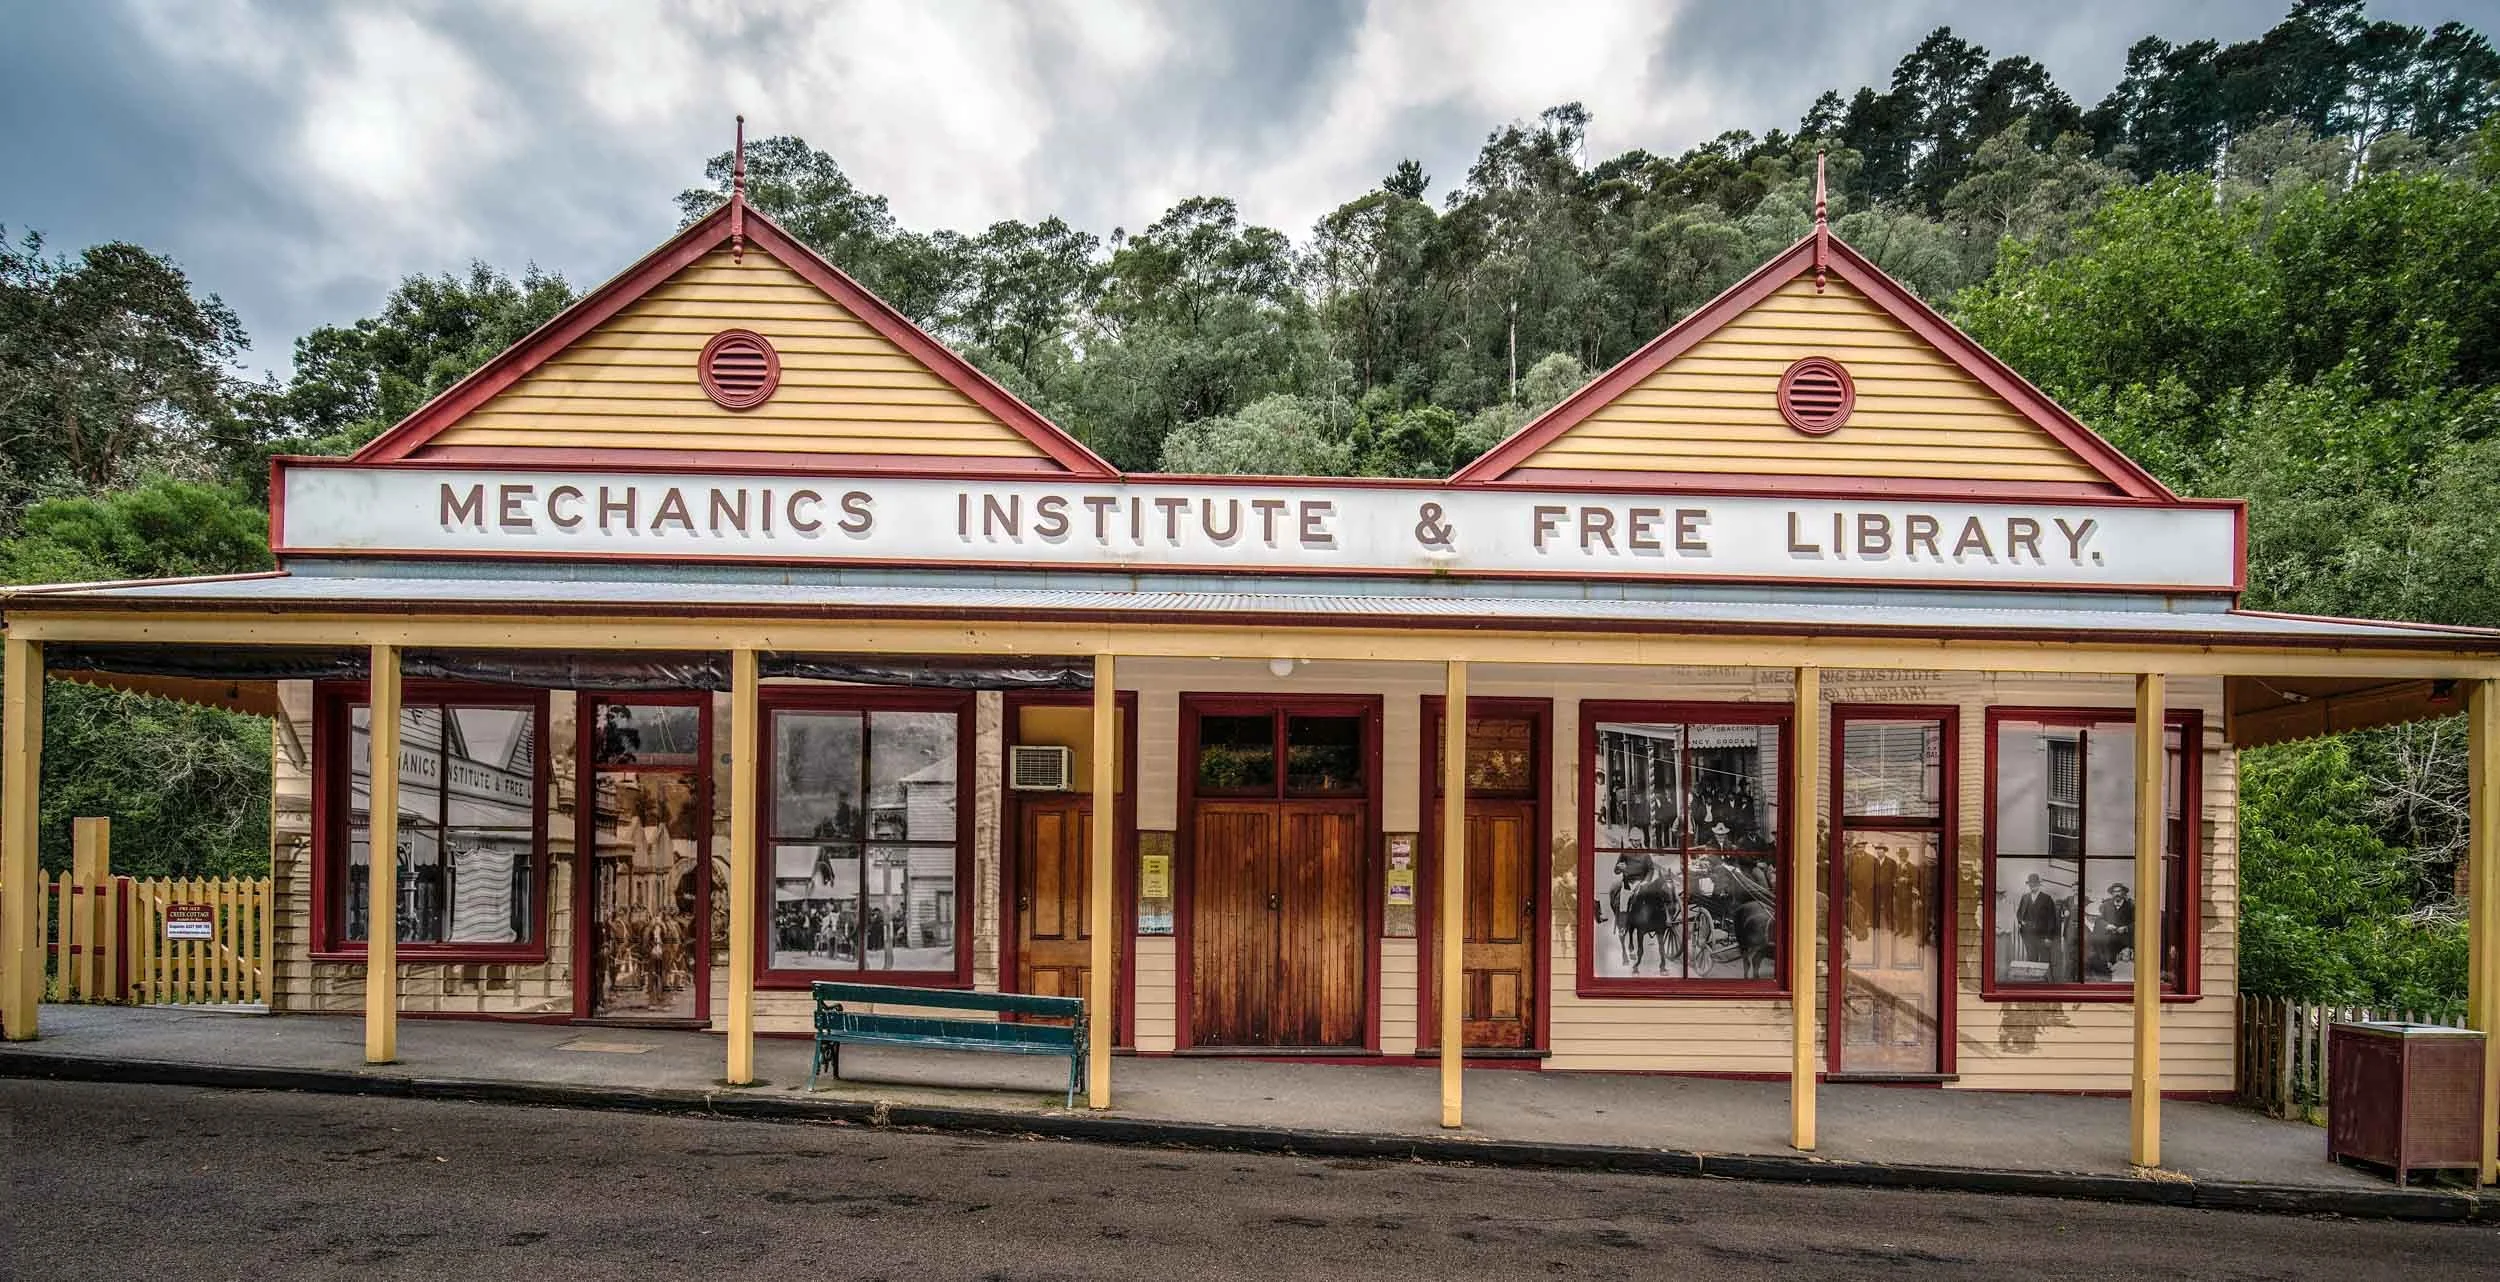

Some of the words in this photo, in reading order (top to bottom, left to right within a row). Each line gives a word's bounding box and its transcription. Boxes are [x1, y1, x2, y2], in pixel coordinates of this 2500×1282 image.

[440, 482, 877, 537] MECHANICS
[957, 493, 1336, 546] INSTITUTE
[1414, 501, 1455, 549] &
[1532, 504, 1712, 554] FREE
[1786, 510, 2103, 563] LIBRARY.
[505, 778, 524, 797] FREE
